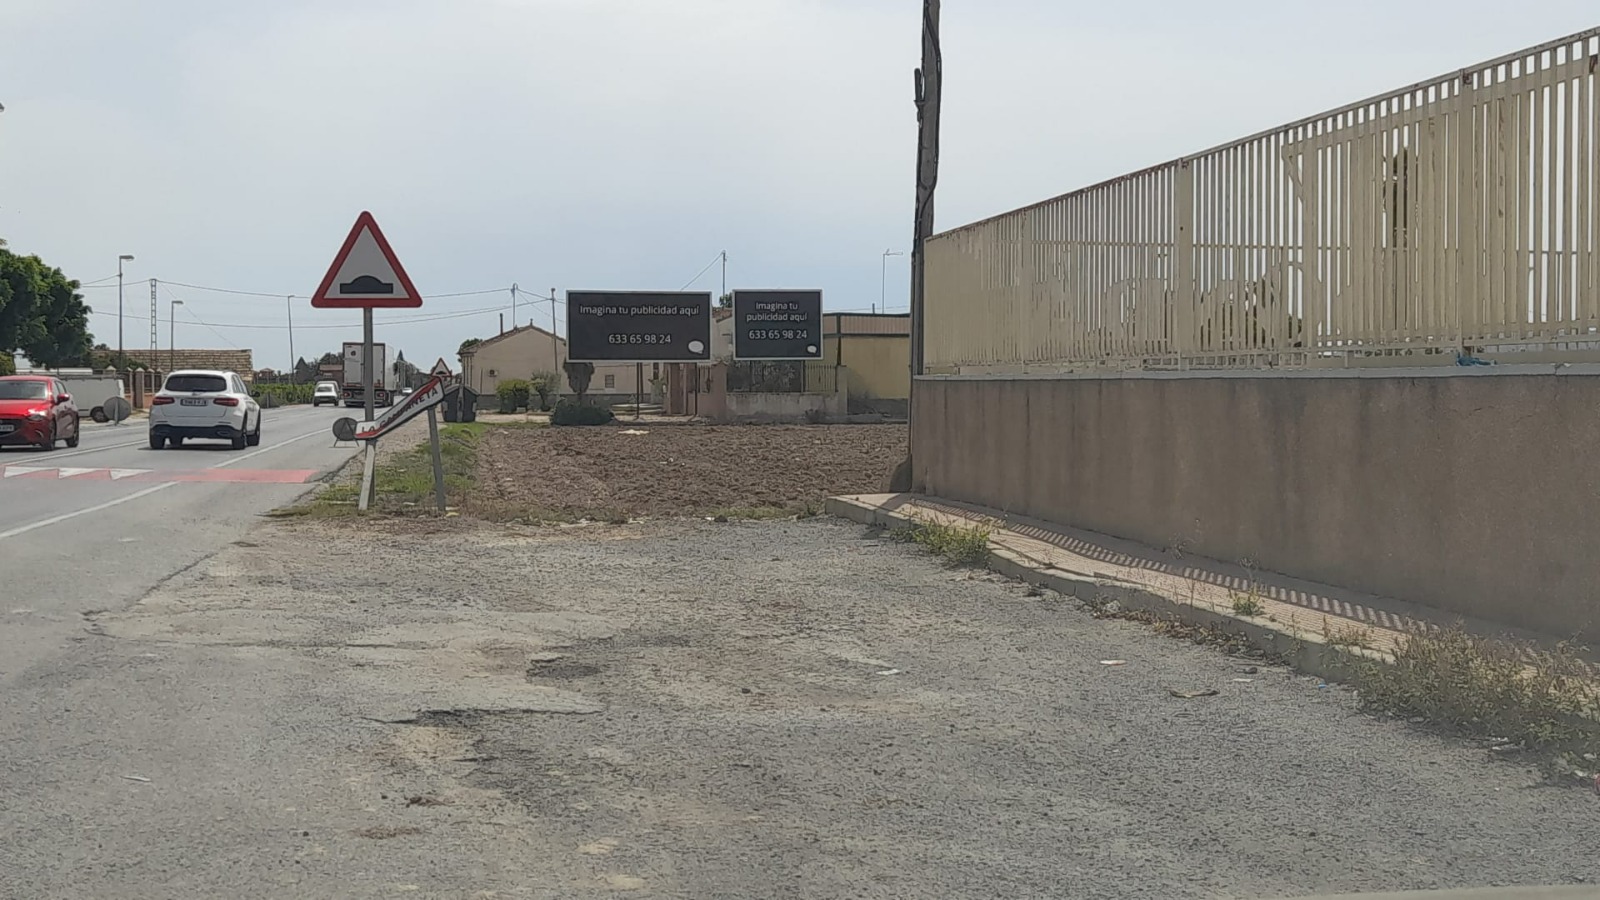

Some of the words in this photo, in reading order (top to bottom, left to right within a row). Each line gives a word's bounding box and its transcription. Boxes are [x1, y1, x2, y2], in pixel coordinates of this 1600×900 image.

[580, 305, 617, 316] Imagina
[619, 306, 629, 314] tu
[630, 306, 678, 316] publicidad
[679, 306, 700, 316] aquí
[755, 302, 788, 312] Imagina
[746, 313, 788, 322] publicidad
[789, 313, 808, 322] aquí
[608, 334, 628, 344] 633
[629, 334, 642, 344] 65
[644, 334, 657, 344] 98
[659, 334, 671, 344] 24
[749, 330, 767, 339] 633
[768, 330, 780, 339] 65
[782, 330, 794, 339] 98
[796, 330, 807, 339] 24
